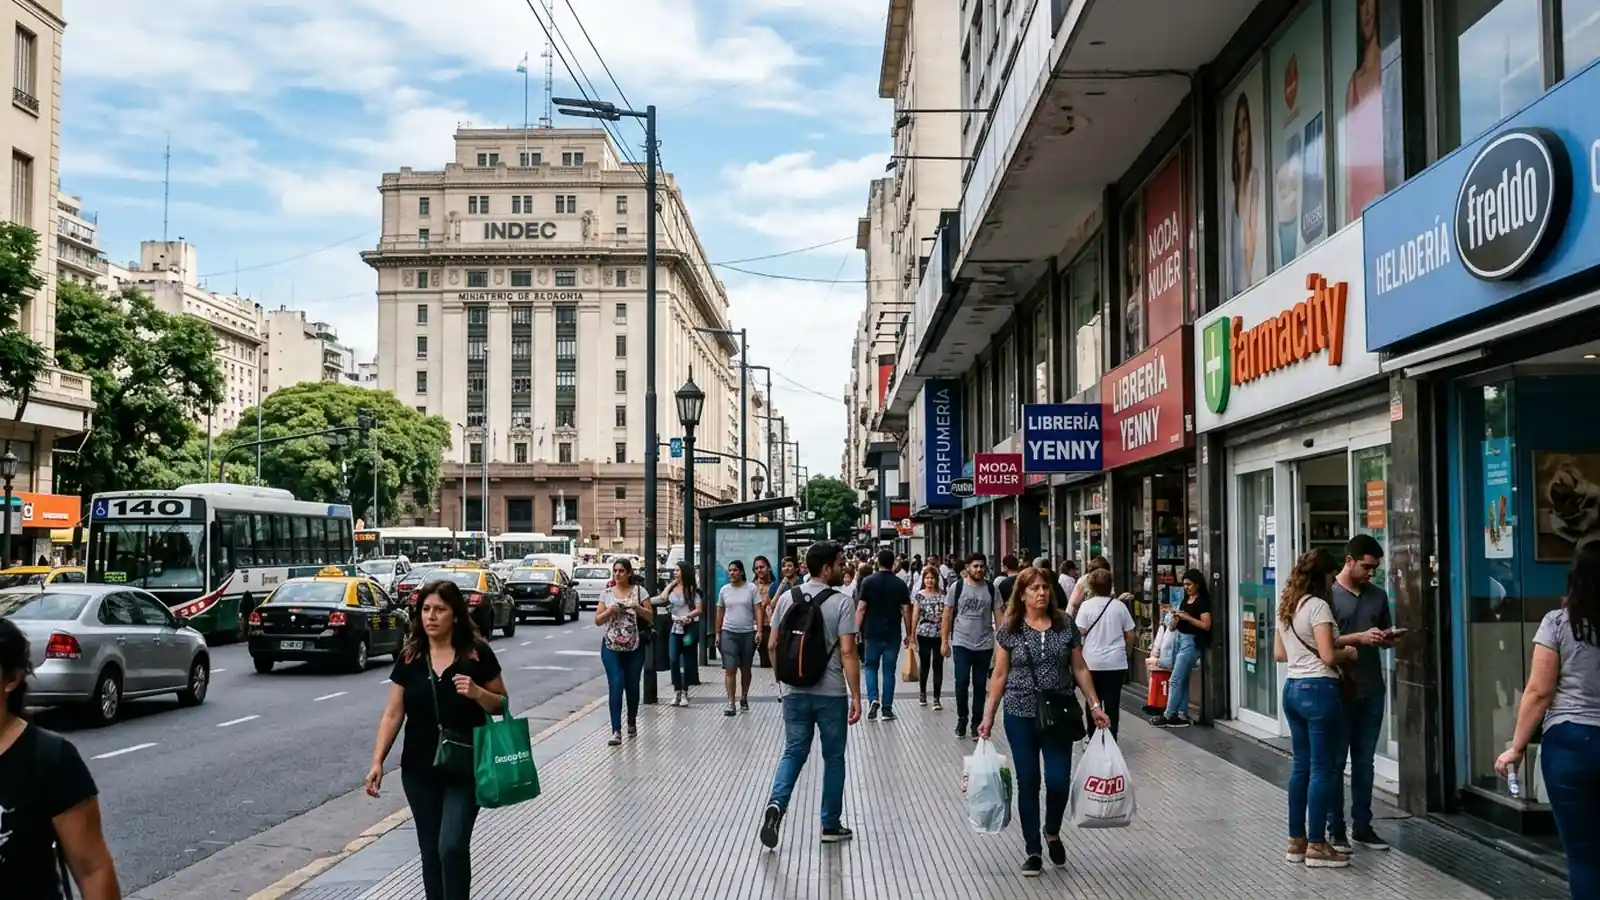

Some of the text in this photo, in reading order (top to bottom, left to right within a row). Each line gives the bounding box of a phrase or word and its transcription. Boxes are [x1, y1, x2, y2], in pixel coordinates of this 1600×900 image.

[1467, 159, 1538, 250] freddo
[484, 221, 558, 240] INDEC
[1375, 214, 1450, 296] HELADERÍA
[1229, 272, 1348, 387] farmacity
[1112, 347, 1168, 414] LIBRERÍA
[933, 388, 951, 495] PERFUMERÍA
[1028, 440, 1100, 460] YENNY
[1119, 404, 1160, 452] YENNY
[978, 474, 1020, 485] MUJER
[979, 462, 1018, 473] MODA
[113, 500, 184, 516] 140
